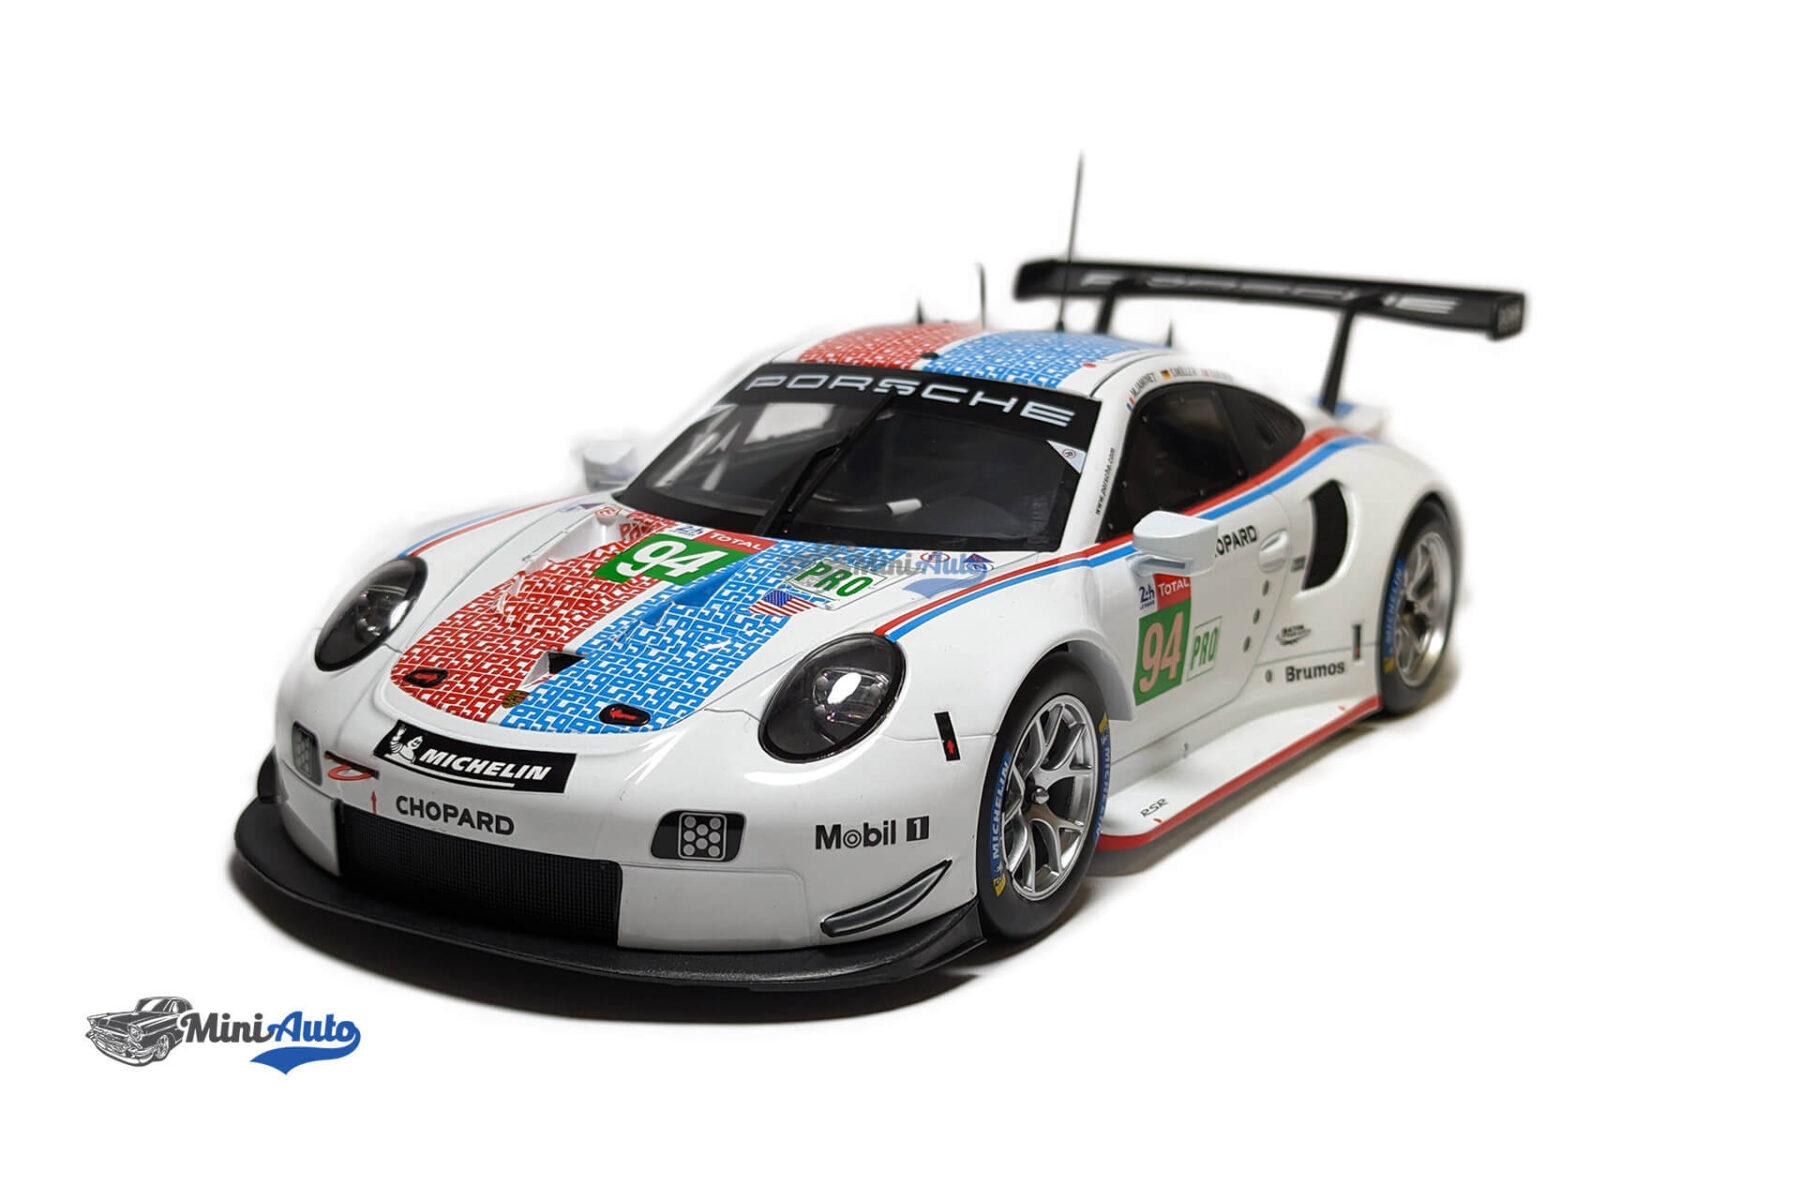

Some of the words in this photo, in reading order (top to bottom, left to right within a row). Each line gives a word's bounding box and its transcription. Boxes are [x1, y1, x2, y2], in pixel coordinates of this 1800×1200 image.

[745, 375, 1076, 427] PORSCHE
[709, 532, 763, 550] TOTAL
[1214, 525, 1258, 557] OPARD
[616, 540, 729, 577] 94
[794, 561, 874, 596] PRO
[1157, 578, 1191, 596] TOTAL
[1139, 611, 1184, 693] 94
[1190, 626, 1219, 671] PRO
[1285, 661, 1345, 682] Brumos
[419, 748, 552, 781] MICHELIN
[396, 796, 515, 835] CHOPARD
[993, 761, 1009, 860] MICHELIN
[815, 819, 896, 850] Mobil
